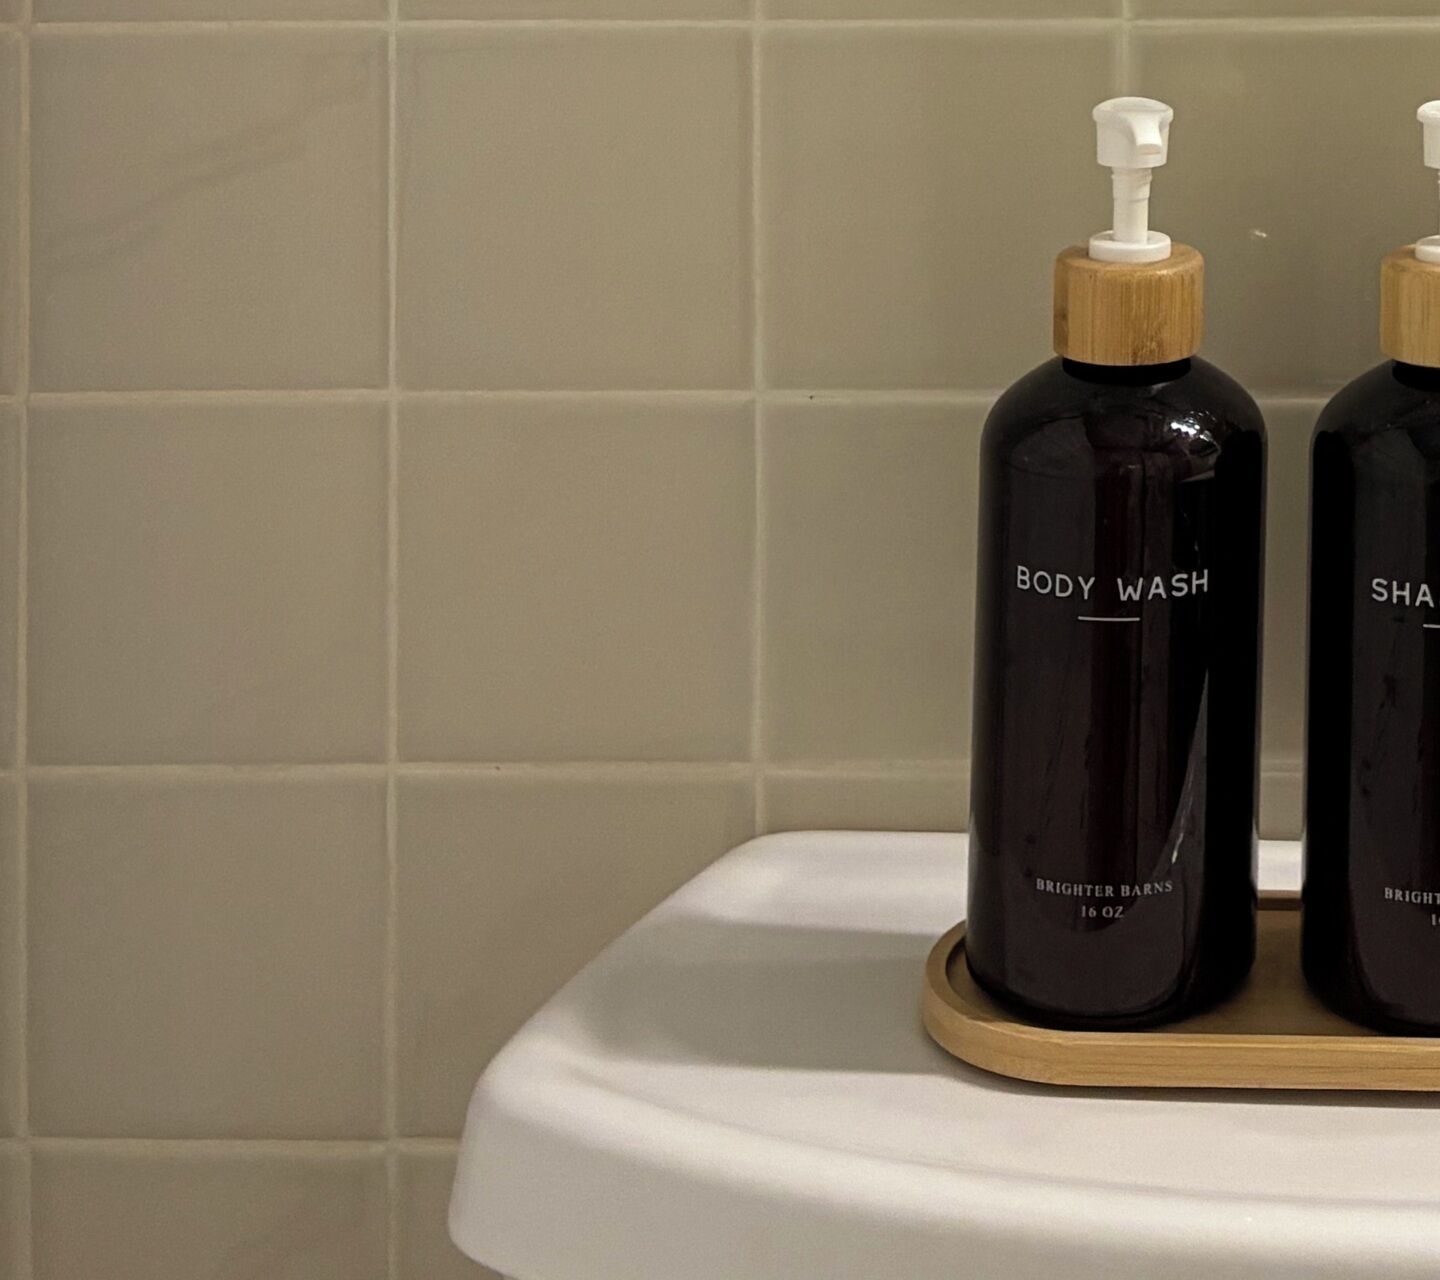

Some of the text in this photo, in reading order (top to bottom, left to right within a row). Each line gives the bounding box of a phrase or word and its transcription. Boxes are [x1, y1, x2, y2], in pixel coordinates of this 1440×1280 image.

[1016, 565, 1209, 601] BODY WASH
[1036, 878, 1173, 897] BRIGHTER BARNS
[1081, 905, 1124, 918] 16 OZ
